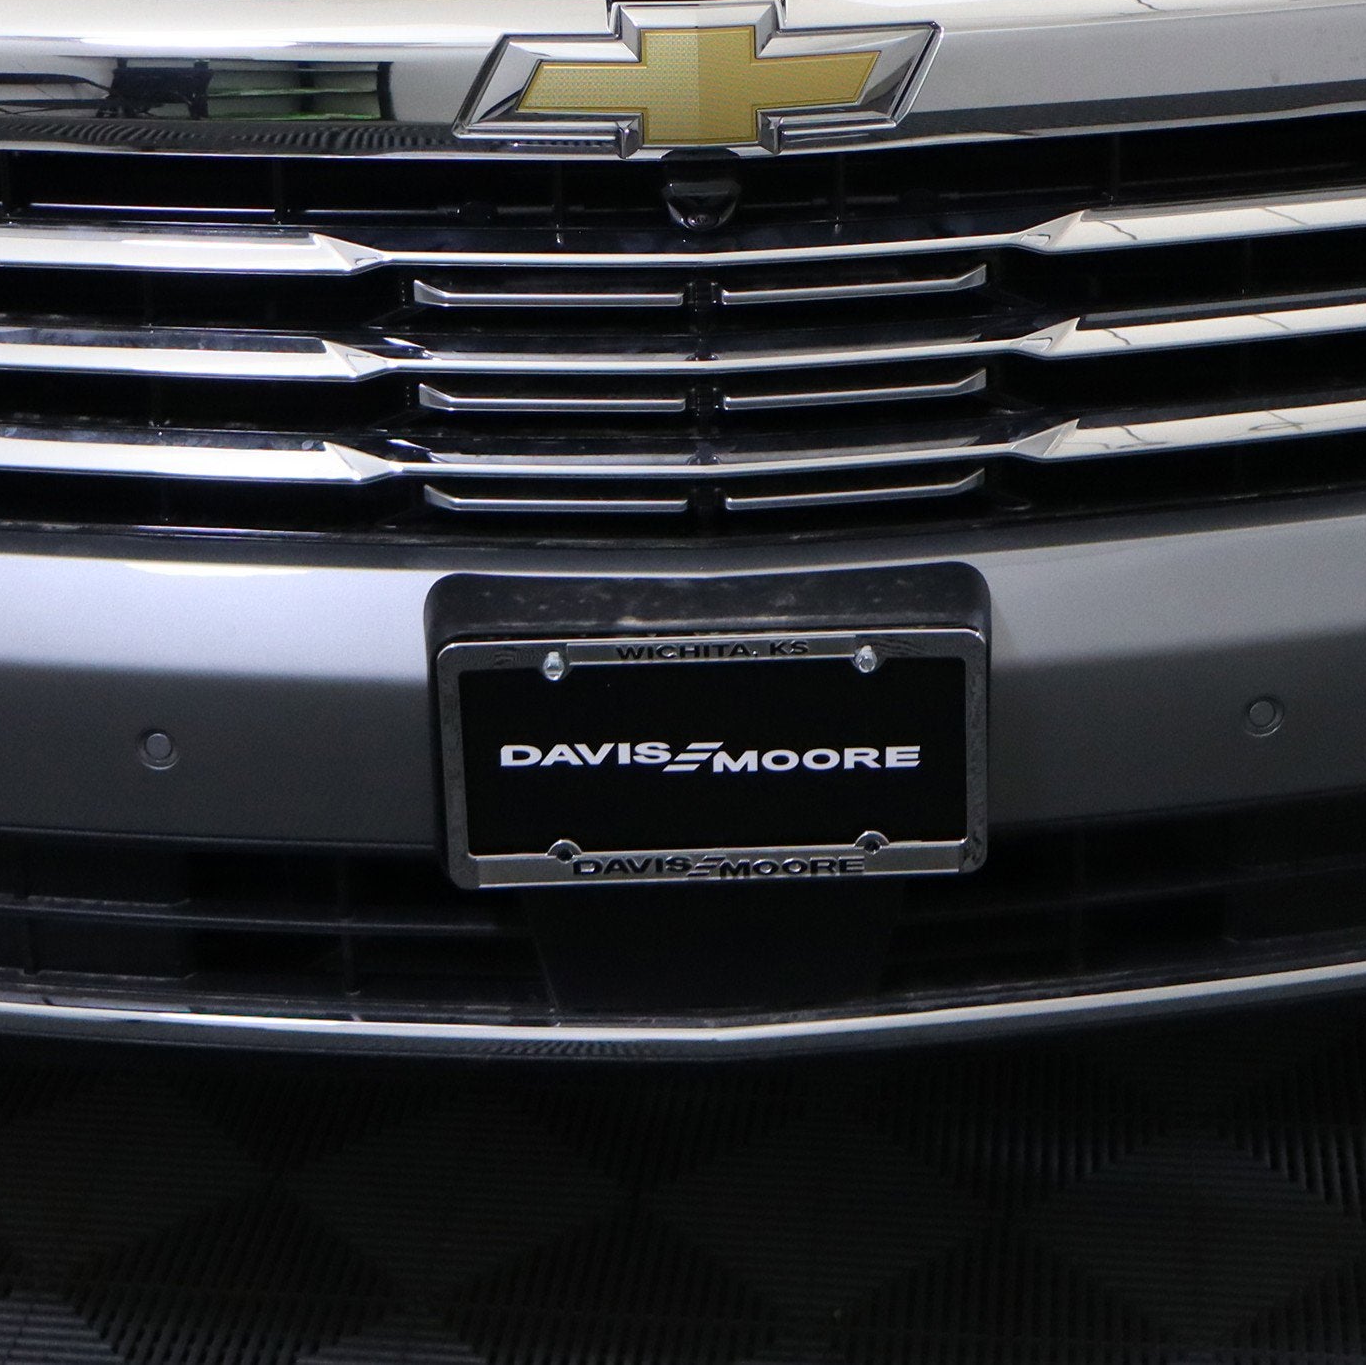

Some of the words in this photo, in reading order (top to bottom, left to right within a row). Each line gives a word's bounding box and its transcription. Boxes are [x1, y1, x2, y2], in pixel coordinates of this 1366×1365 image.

[768, 639, 811, 657] KS
[499, 741, 673, 768] DAVIS
[712, 744, 921, 774] MOORE
[572, 855, 693, 876] DAVIS
[718, 855, 866, 879] MOORE
